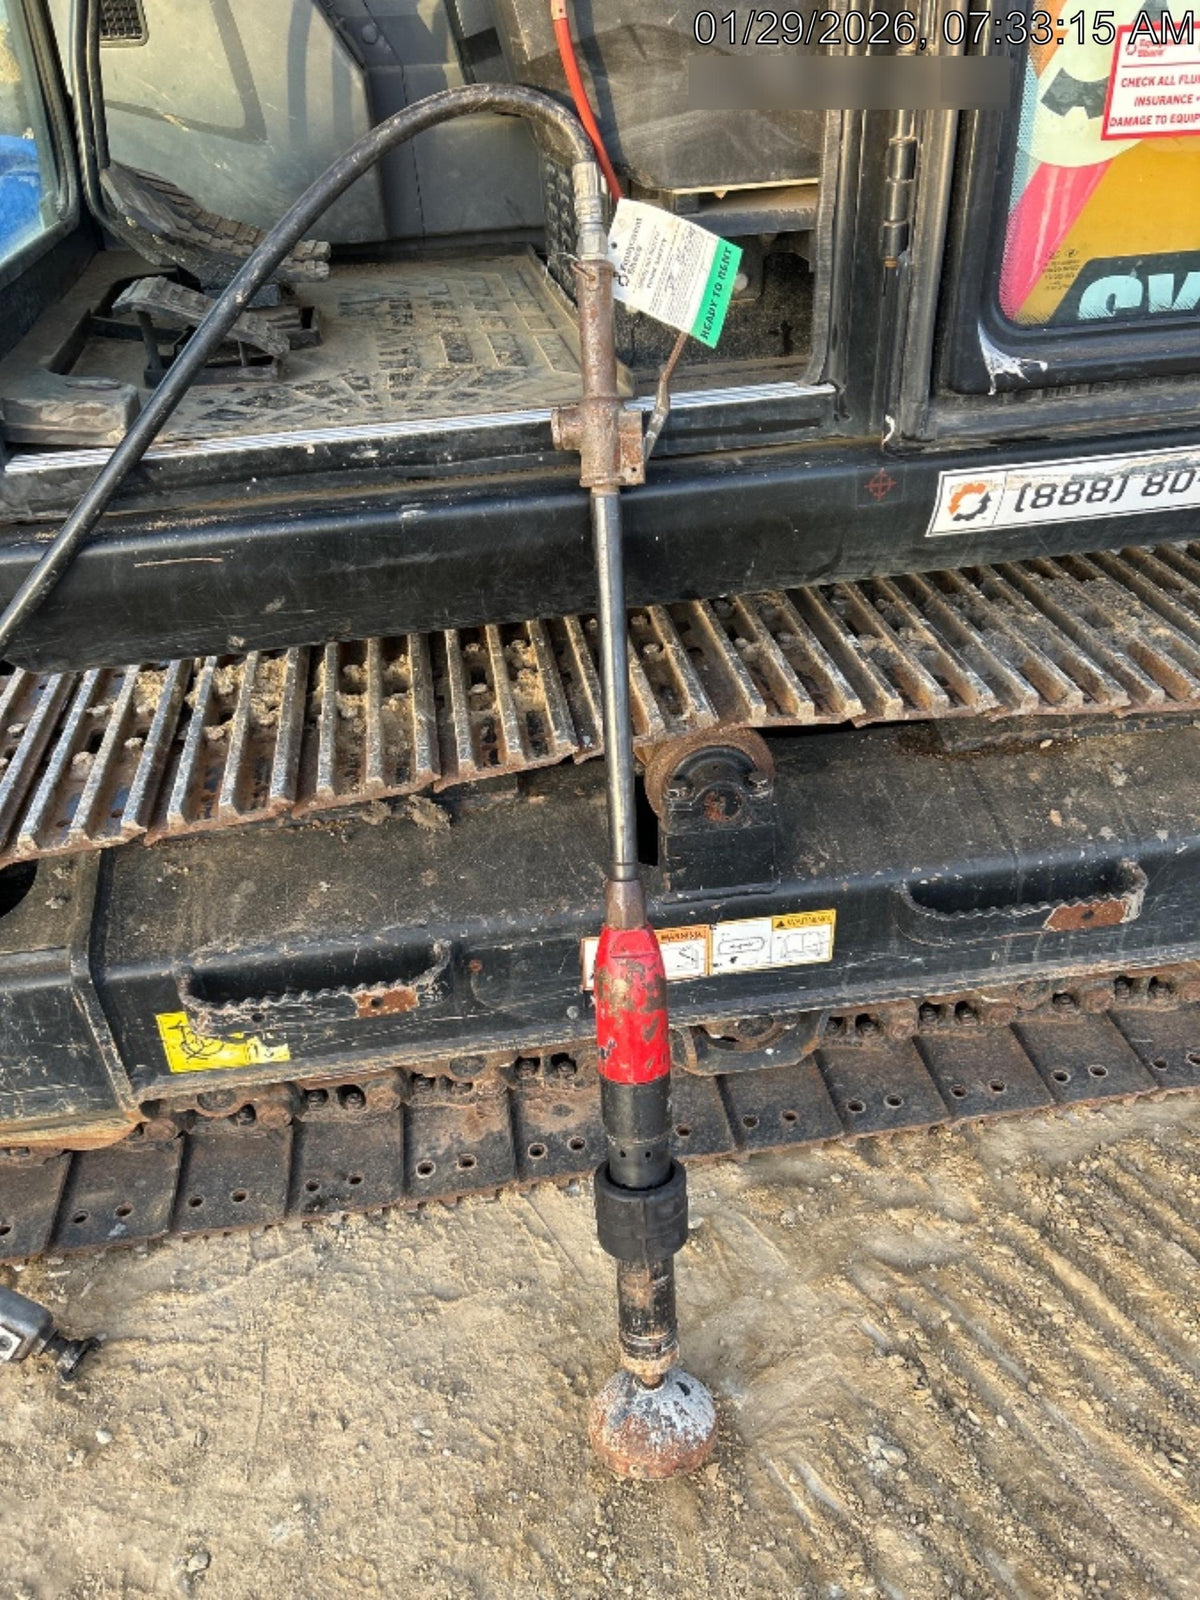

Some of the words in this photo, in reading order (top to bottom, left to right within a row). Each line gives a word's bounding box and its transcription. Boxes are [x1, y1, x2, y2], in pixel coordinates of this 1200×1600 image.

[1121, 76, 1156, 88] CHECK
[1157, 75, 1176, 86] ALL
[1134, 94, 1193, 107] INSURANCE
[1109, 115, 1153, 127] DAMAGE
[1154, 114, 1168, 124] TO
[700, 299, 717, 340] READY
[712, 282, 723, 298] TO
[718, 246, 732, 280] RENT
[1015, 475, 1130, 512] (888)
[1141, 469, 1200, 497] 80
